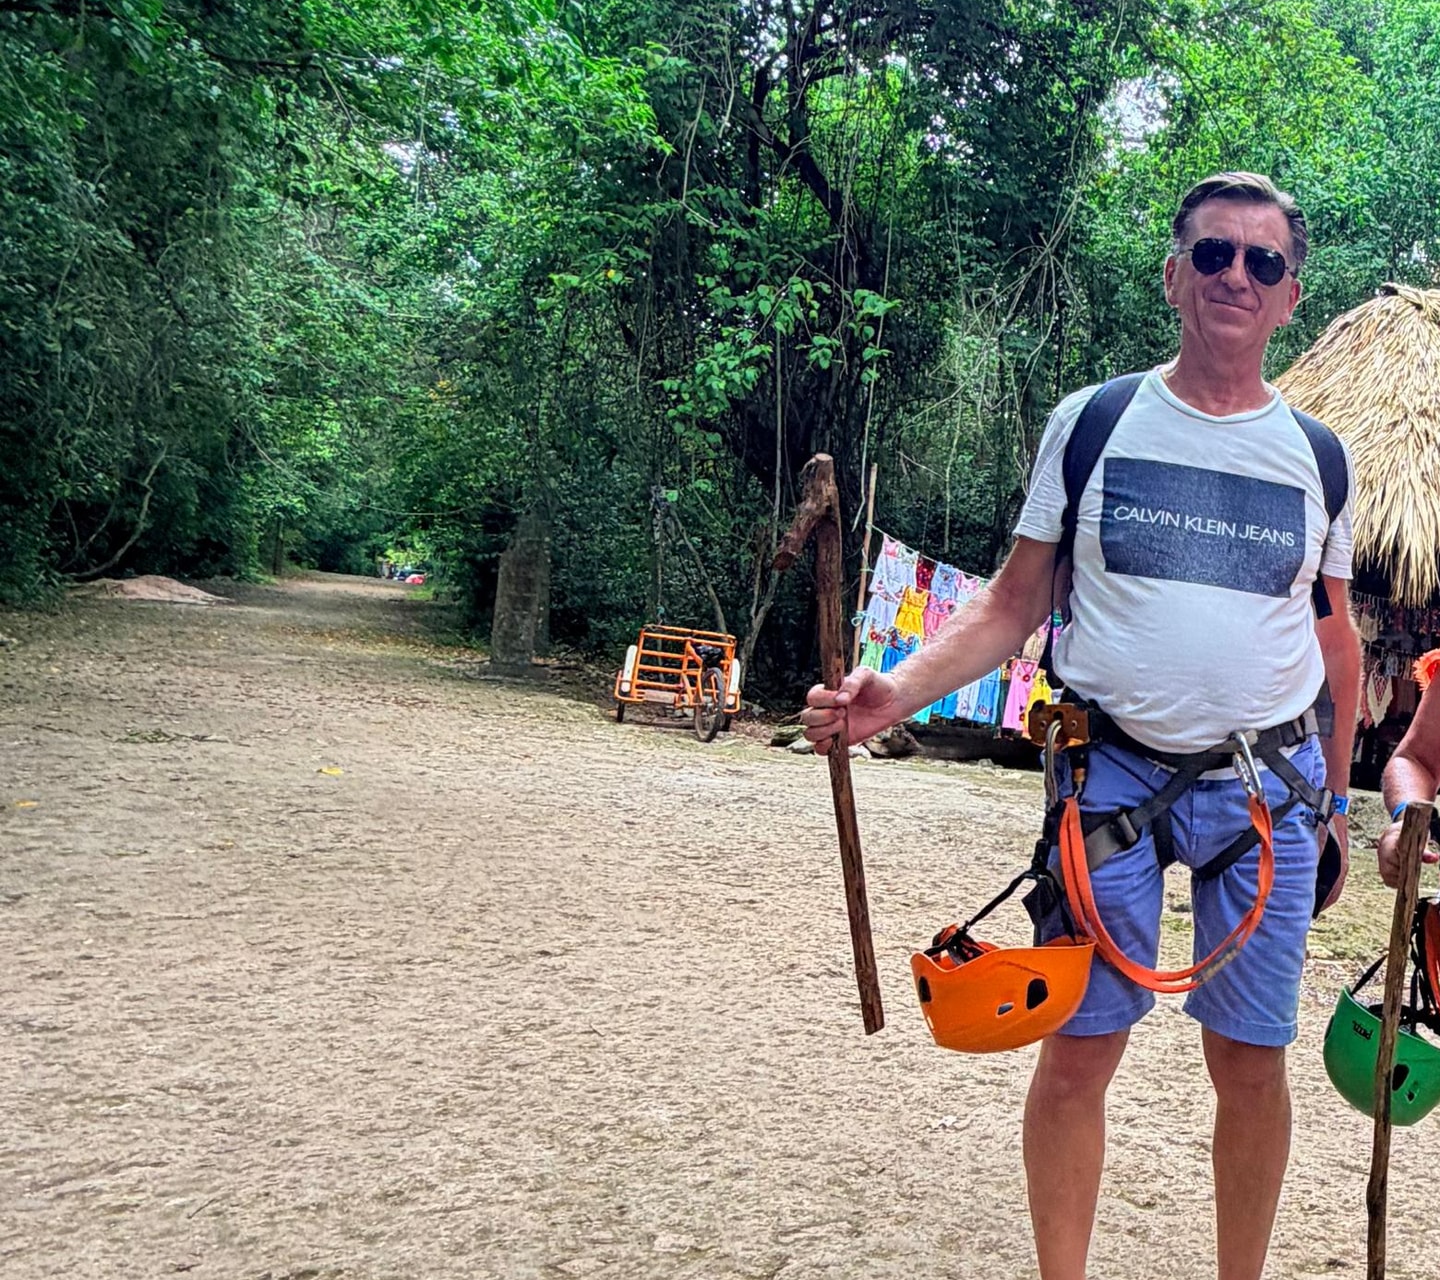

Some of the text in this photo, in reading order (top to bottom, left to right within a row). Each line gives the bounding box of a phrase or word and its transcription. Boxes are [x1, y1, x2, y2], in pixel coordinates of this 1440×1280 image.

[1113, 506, 1295, 547] CALVIN KLEIN JEANS
